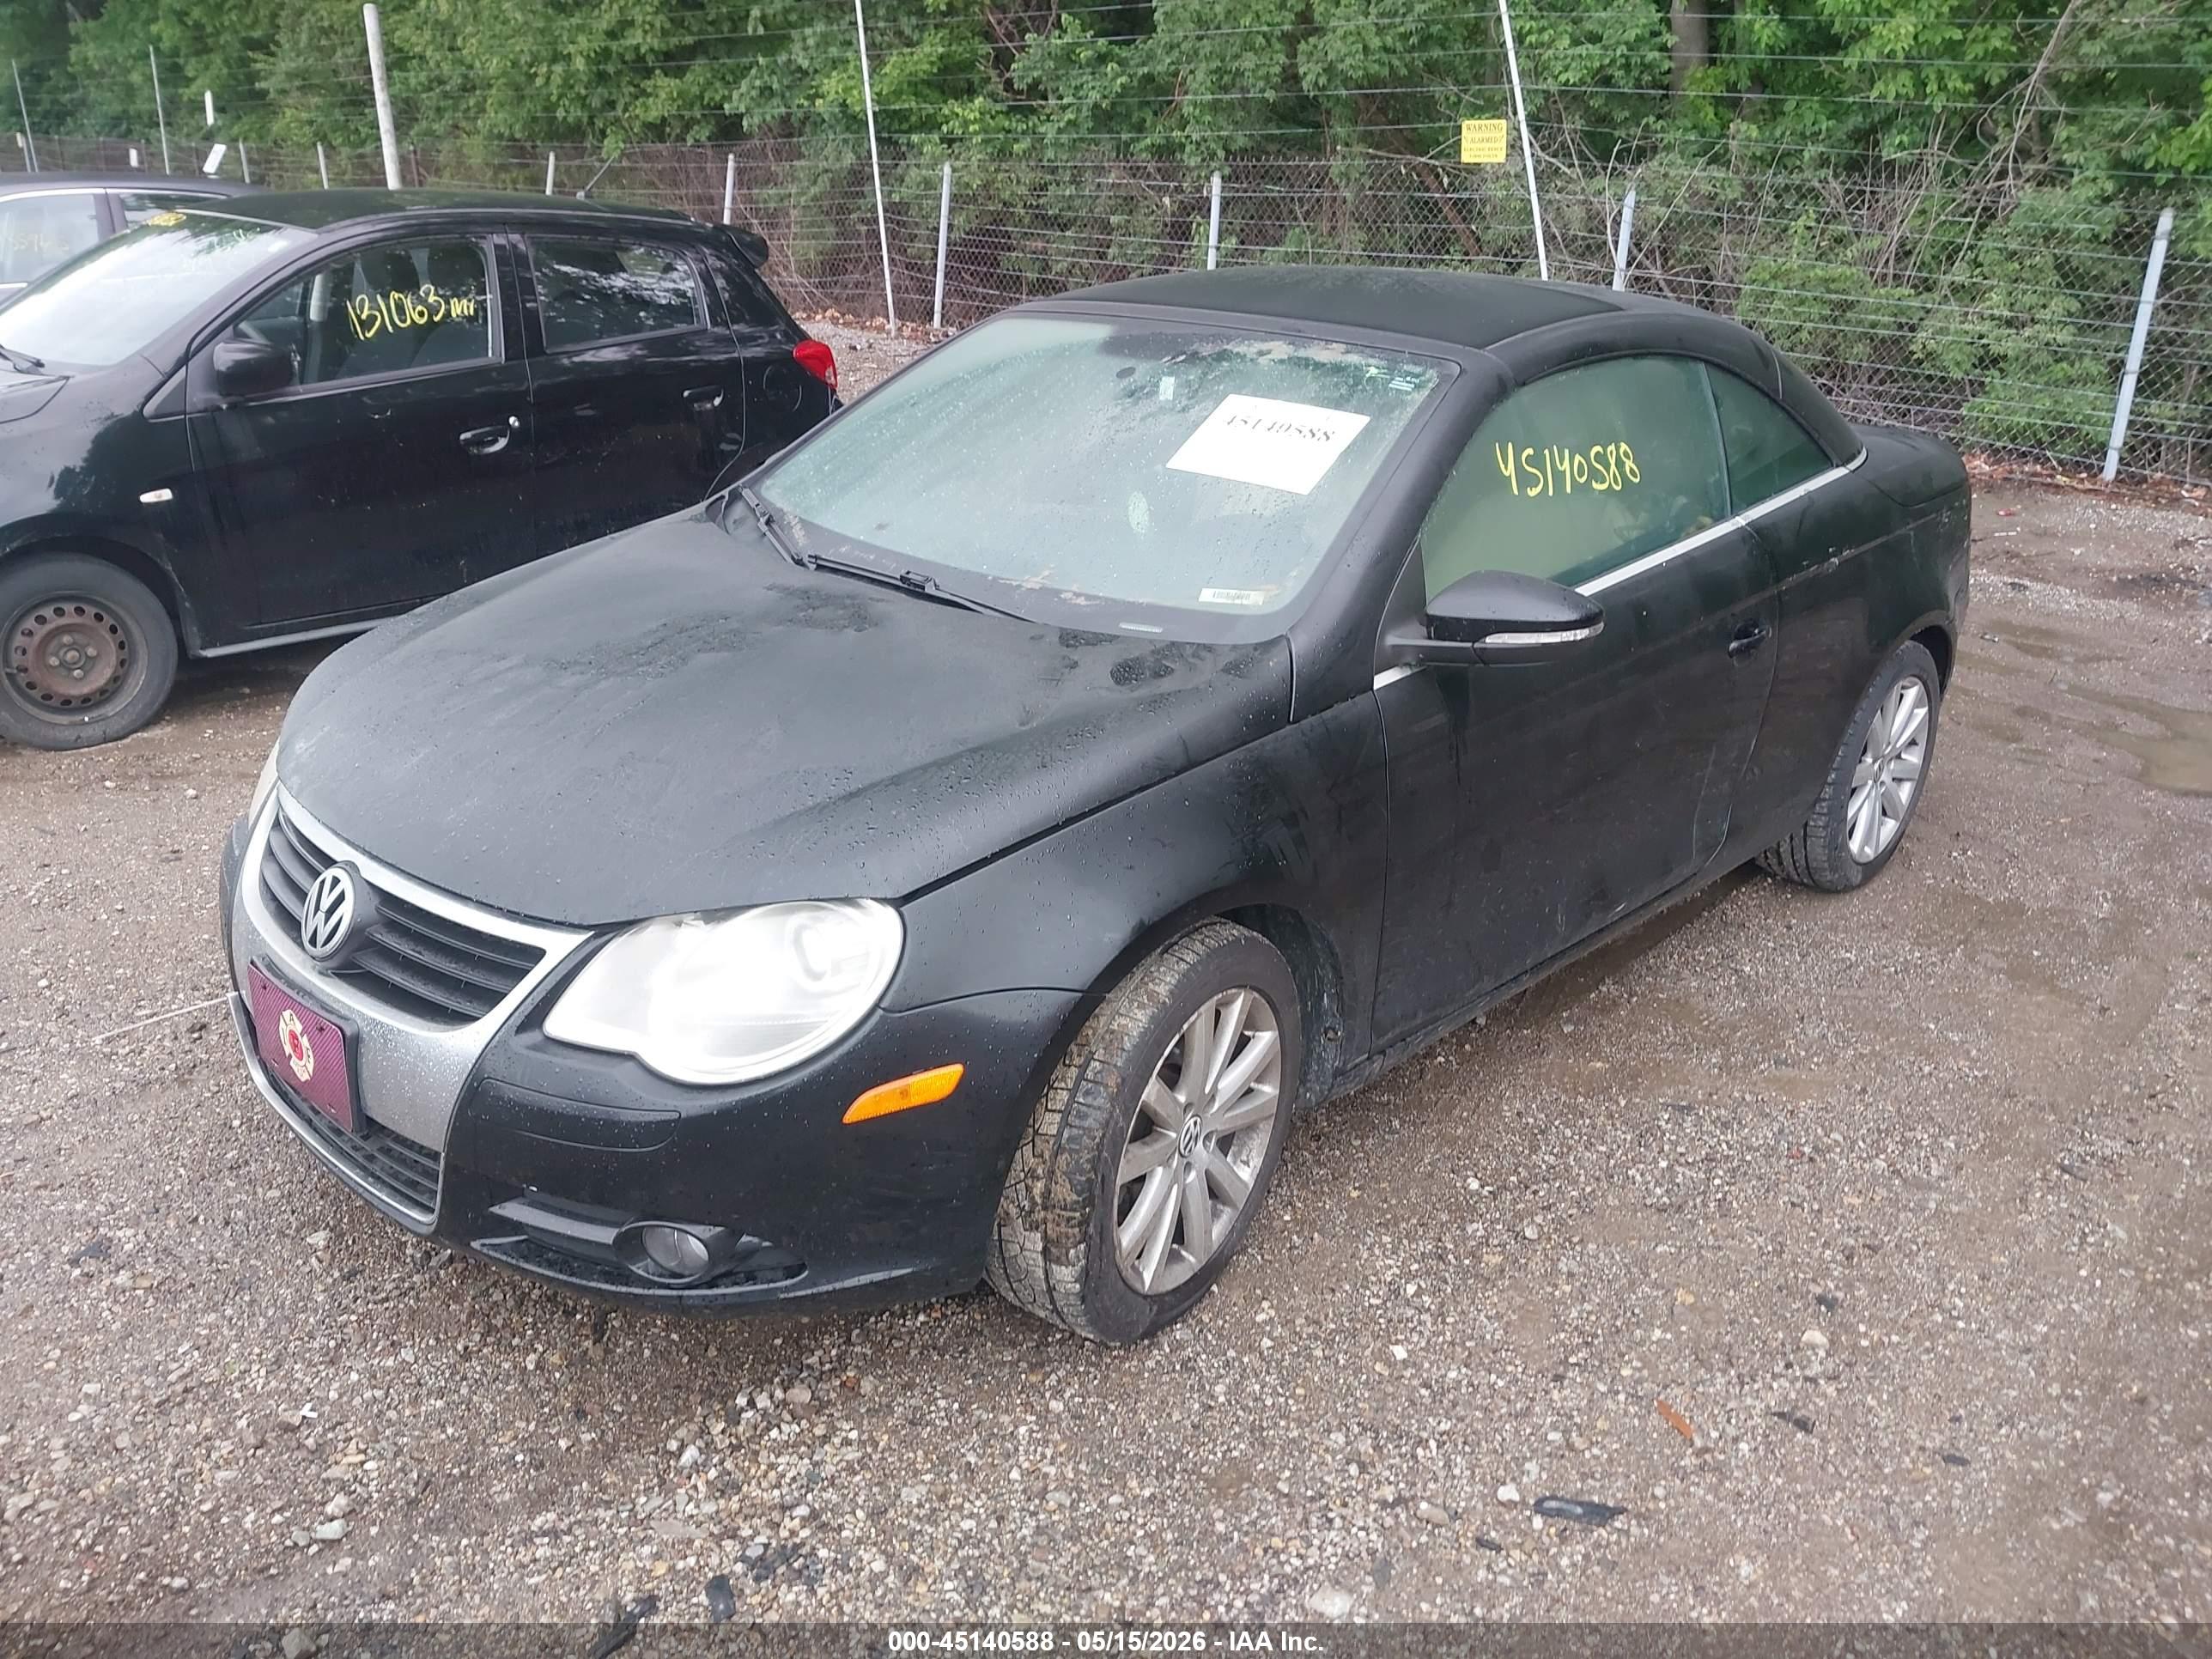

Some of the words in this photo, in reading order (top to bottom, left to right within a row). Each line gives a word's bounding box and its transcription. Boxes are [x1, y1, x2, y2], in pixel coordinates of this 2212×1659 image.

[1466, 123, 1504, 131] WARNING
[346, 283, 445, 341] 131063
[301, 866, 355, 959] VW
